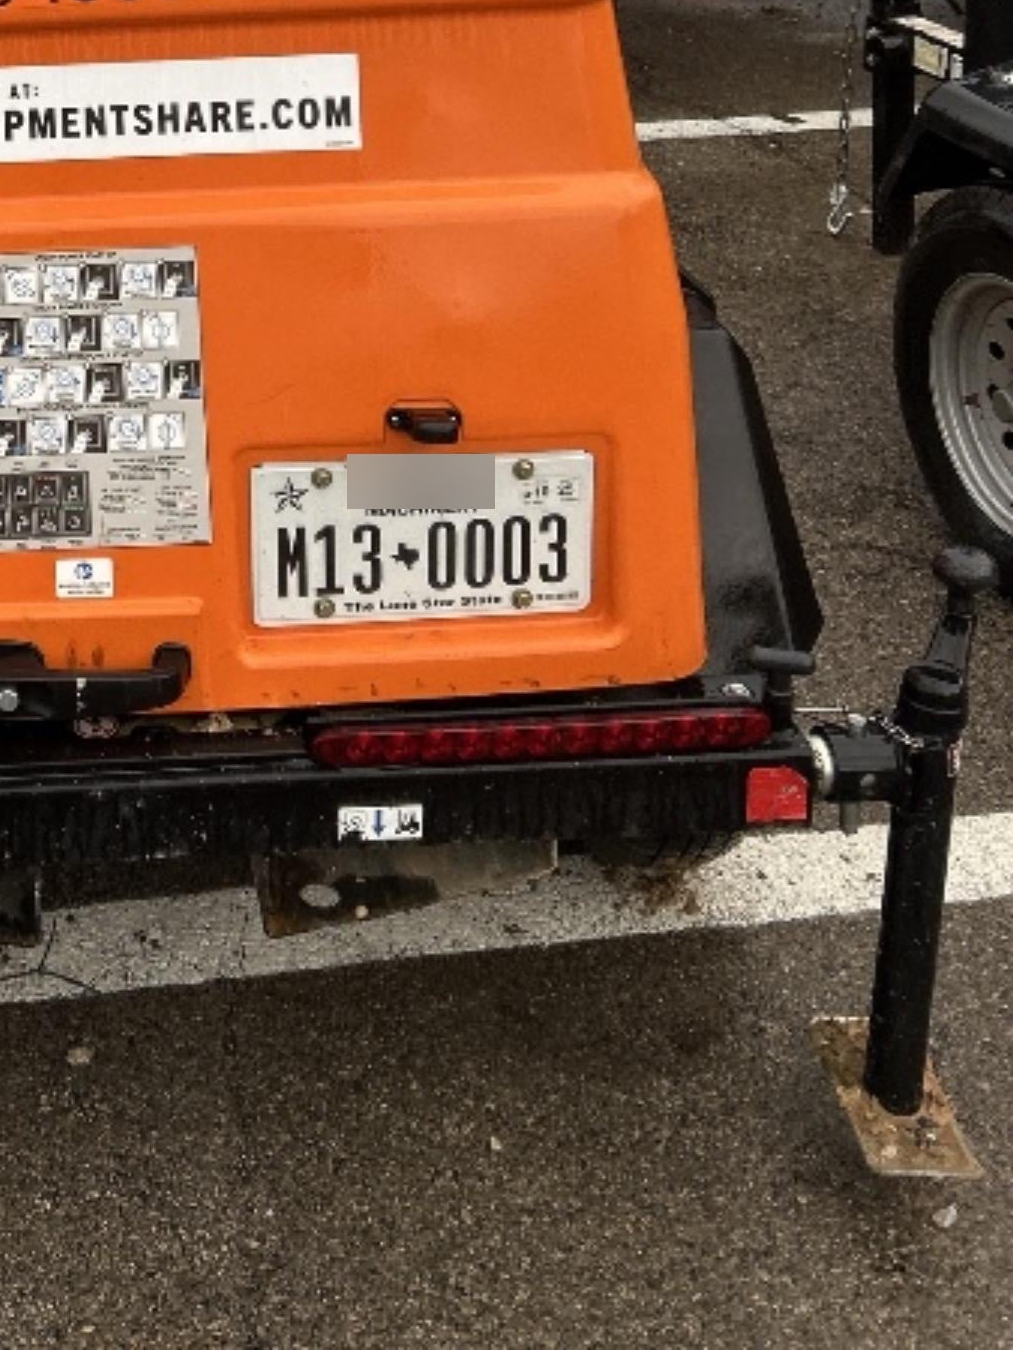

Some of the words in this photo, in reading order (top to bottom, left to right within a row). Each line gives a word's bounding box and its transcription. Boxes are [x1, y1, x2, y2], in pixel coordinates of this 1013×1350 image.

[10, 83, 39, 100] AT:
[277, 524, 382, 598] M13
[427, 513, 568, 589] 0003
